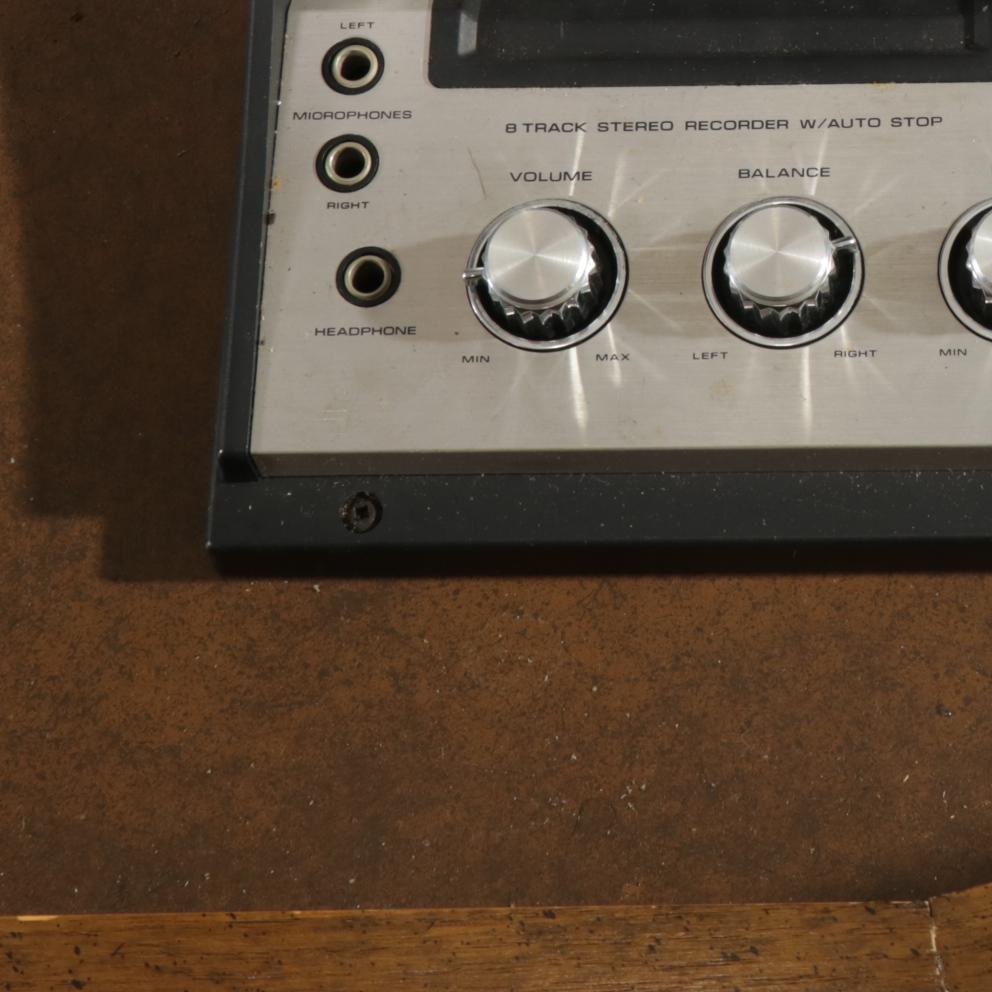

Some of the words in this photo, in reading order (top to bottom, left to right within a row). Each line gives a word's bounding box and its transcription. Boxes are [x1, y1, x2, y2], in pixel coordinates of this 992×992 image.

[339, 21, 374, 30] LEFT
[292, 110, 412, 121] MICROPHONES
[505, 122, 517, 134] 8
[522, 122, 587, 133] TRACK
[597, 120, 674, 133] STEREO
[684, 119, 789, 131] RECORDER
[799, 117, 882, 130] W/AUTO
[890, 116, 943, 128] STOP
[509, 170, 593, 183] VOLUME
[737, 167, 830, 179] BALANCE
[326, 201, 369, 210] RIGHT
[314, 325, 417, 337] HEADPHONE
[692, 351, 729, 361] LEFT
[833, 349, 877, 358] RIGHT
[939, 348, 968, 357] MIN
[461, 355, 491, 364] MIN
[595, 353, 630, 362] MAX
